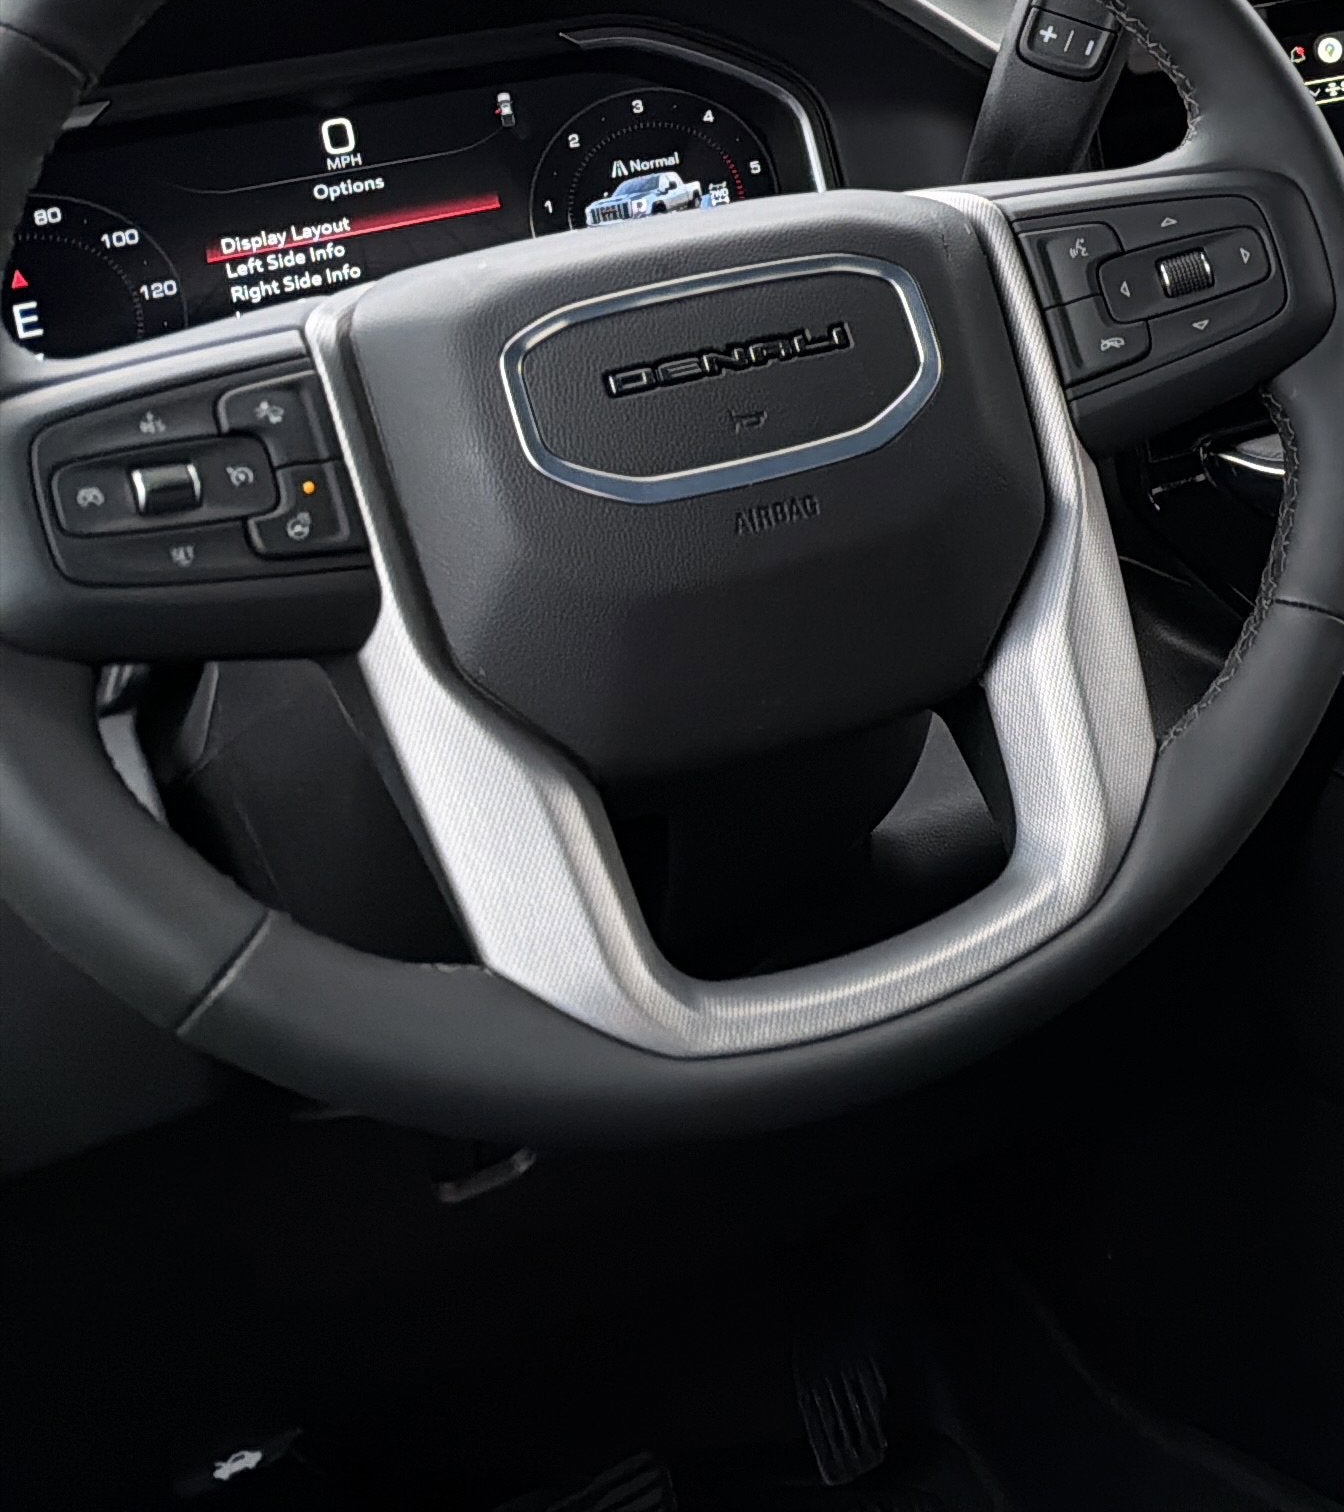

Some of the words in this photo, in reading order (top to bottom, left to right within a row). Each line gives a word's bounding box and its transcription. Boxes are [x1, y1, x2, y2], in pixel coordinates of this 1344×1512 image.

[631, 99, 645, 114] 3
[702, 109, 715, 123] 4
[568, 133, 581, 148] 2
[326, 153, 363, 171] MPH
[629, 151, 681, 173] Normal
[749, 160, 762, 174] 5
[313, 176, 385, 201] Options
[33, 206, 63, 226] 80
[543, 200, 553, 214] 1
[100, 228, 139, 250] 100
[220, 228, 287, 255] Display
[290, 217, 351, 243] Layout
[225, 256, 263, 279] Left
[266, 250, 306, 273] Side
[309, 243, 346, 265] Info
[139, 279, 178, 301] 120
[229, 278, 281, 304] Right
[283, 271, 322, 294] Side
[325, 263, 362, 286] Info
[12, 301, 44, 339] E
[602, 322, 855, 398] DENALI
[735, 494, 822, 535] AIRBAG
